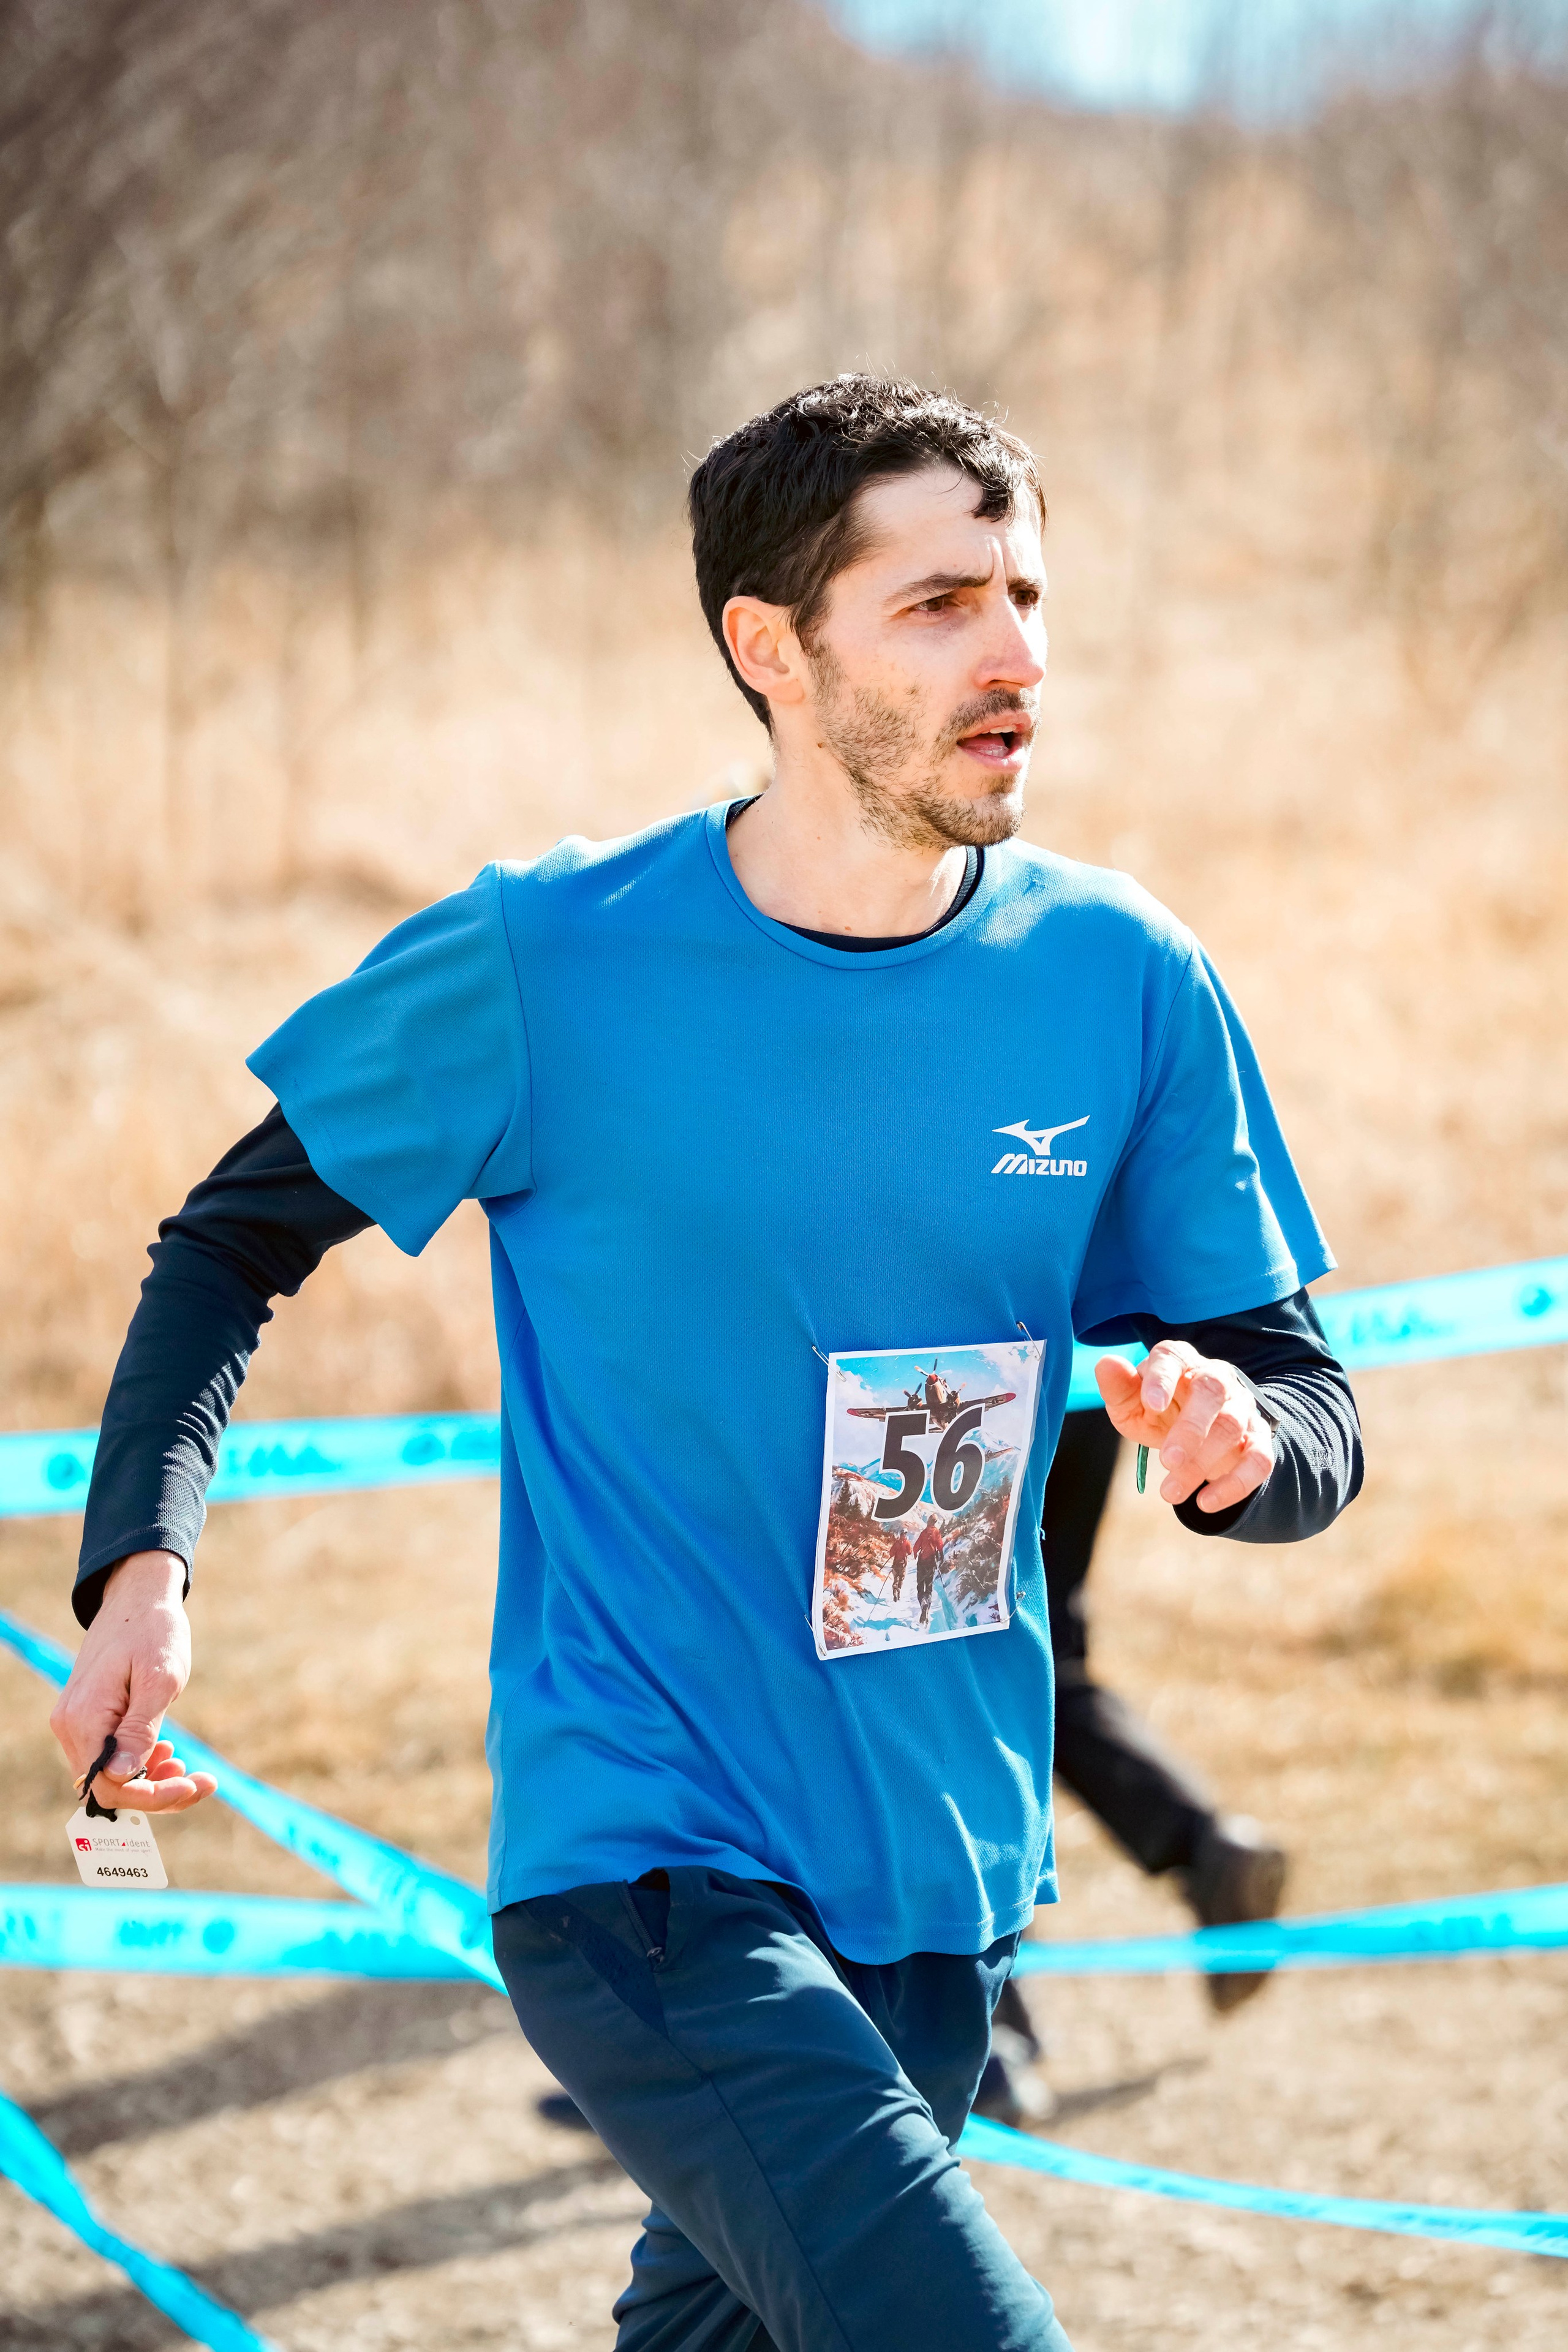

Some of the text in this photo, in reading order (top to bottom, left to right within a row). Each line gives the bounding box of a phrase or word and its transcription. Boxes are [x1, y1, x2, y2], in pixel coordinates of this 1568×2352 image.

[990, 1153, 1087, 1177] MIZUNO
[872, 1404, 984, 1520] 56
[97, 1867, 148, 1878] 4649463
